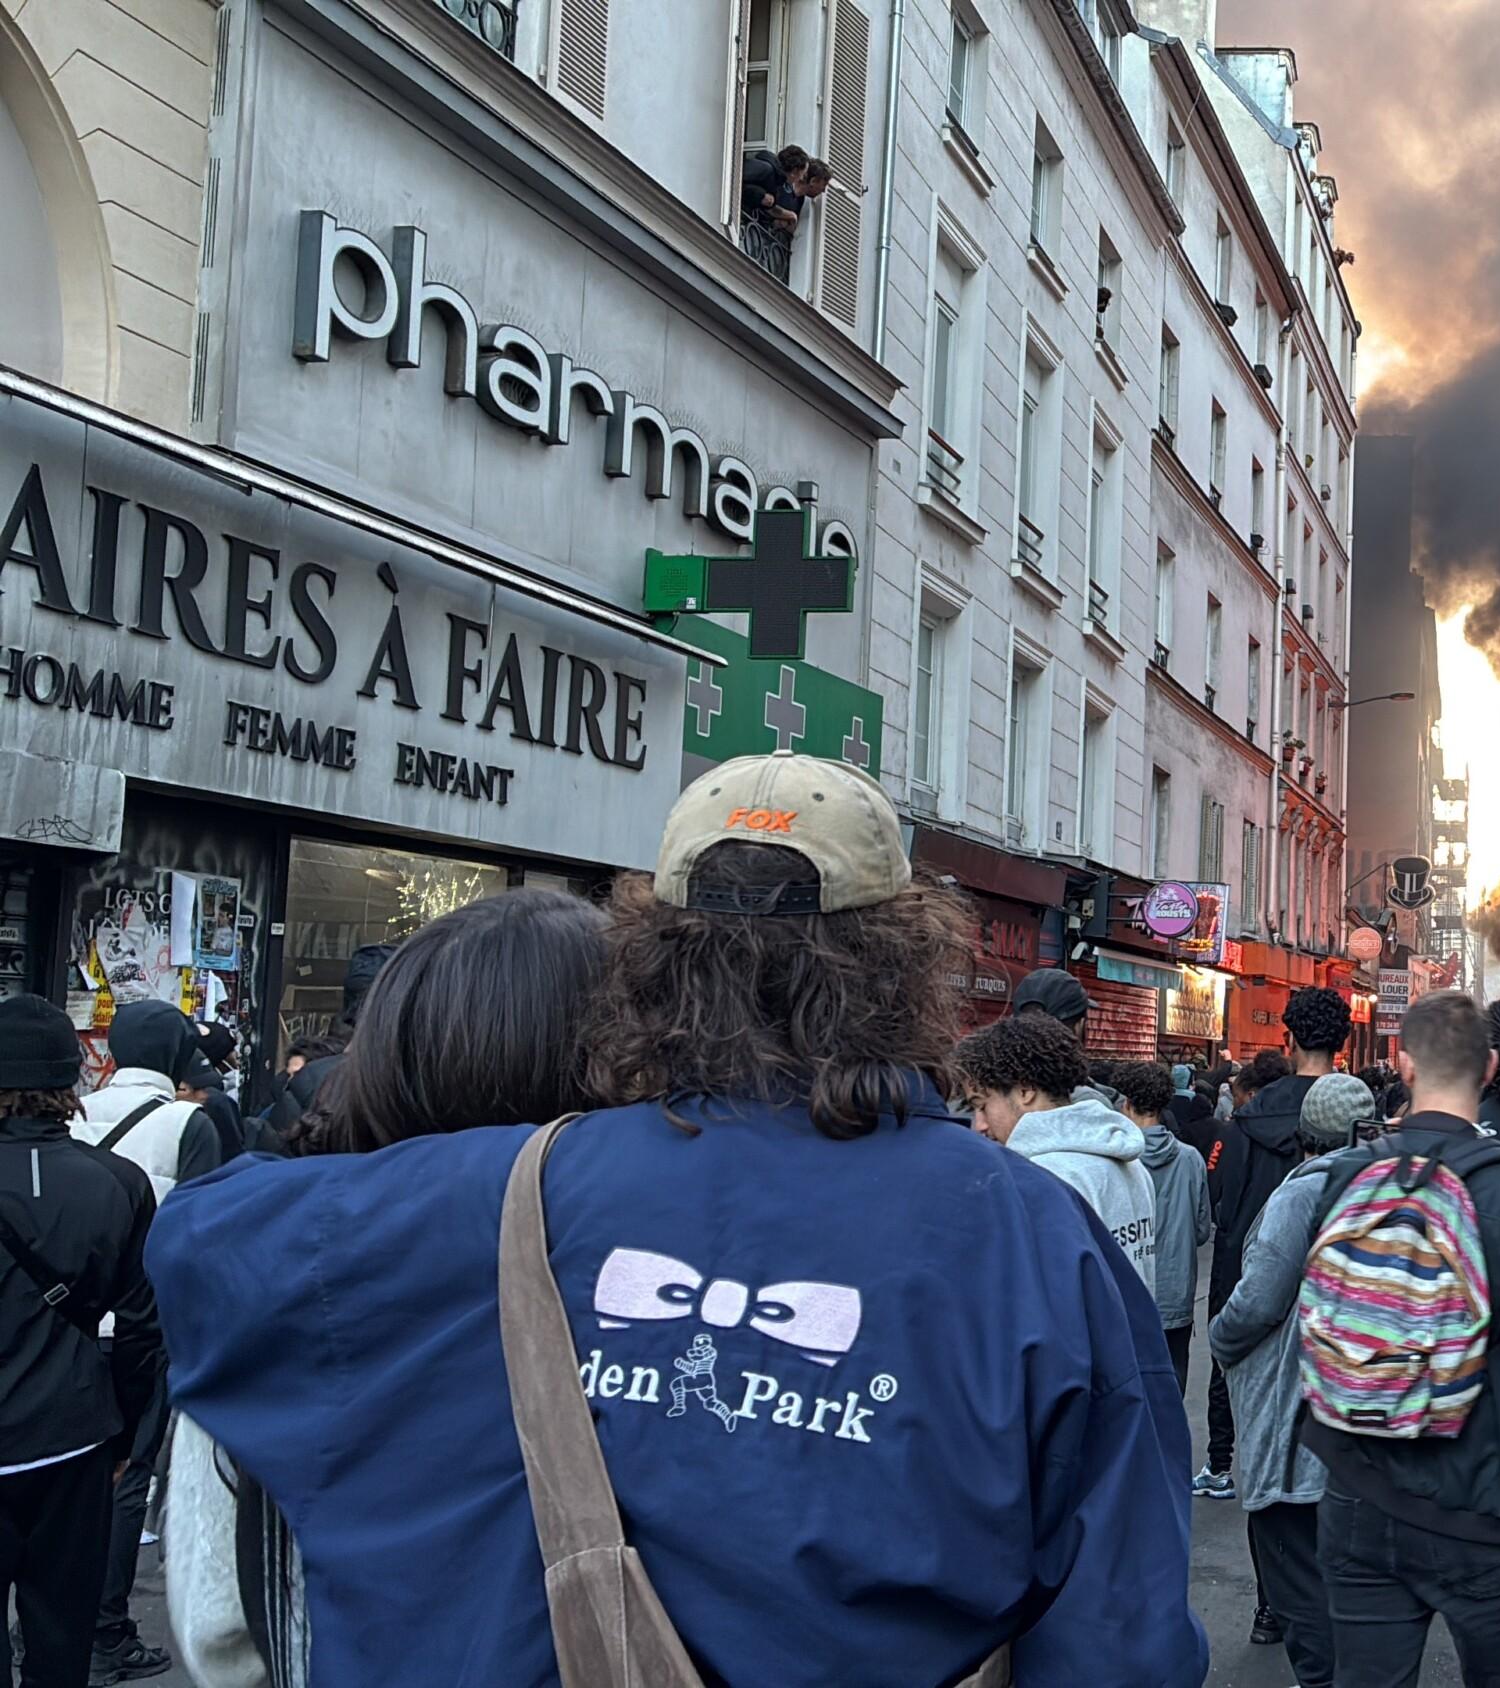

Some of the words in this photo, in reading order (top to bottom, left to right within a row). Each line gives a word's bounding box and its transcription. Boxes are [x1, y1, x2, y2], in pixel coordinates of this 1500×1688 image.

[356, 561, 422, 711] À
[440, 612, 648, 772] FAIRE
[224, 699, 356, 772] FEMME
[394, 742, 514, 805] ENFANT
[725, 807, 798, 833] FOX
[1382, 985, 1409, 995] LOUER
[580, 1350, 660, 1403] den
